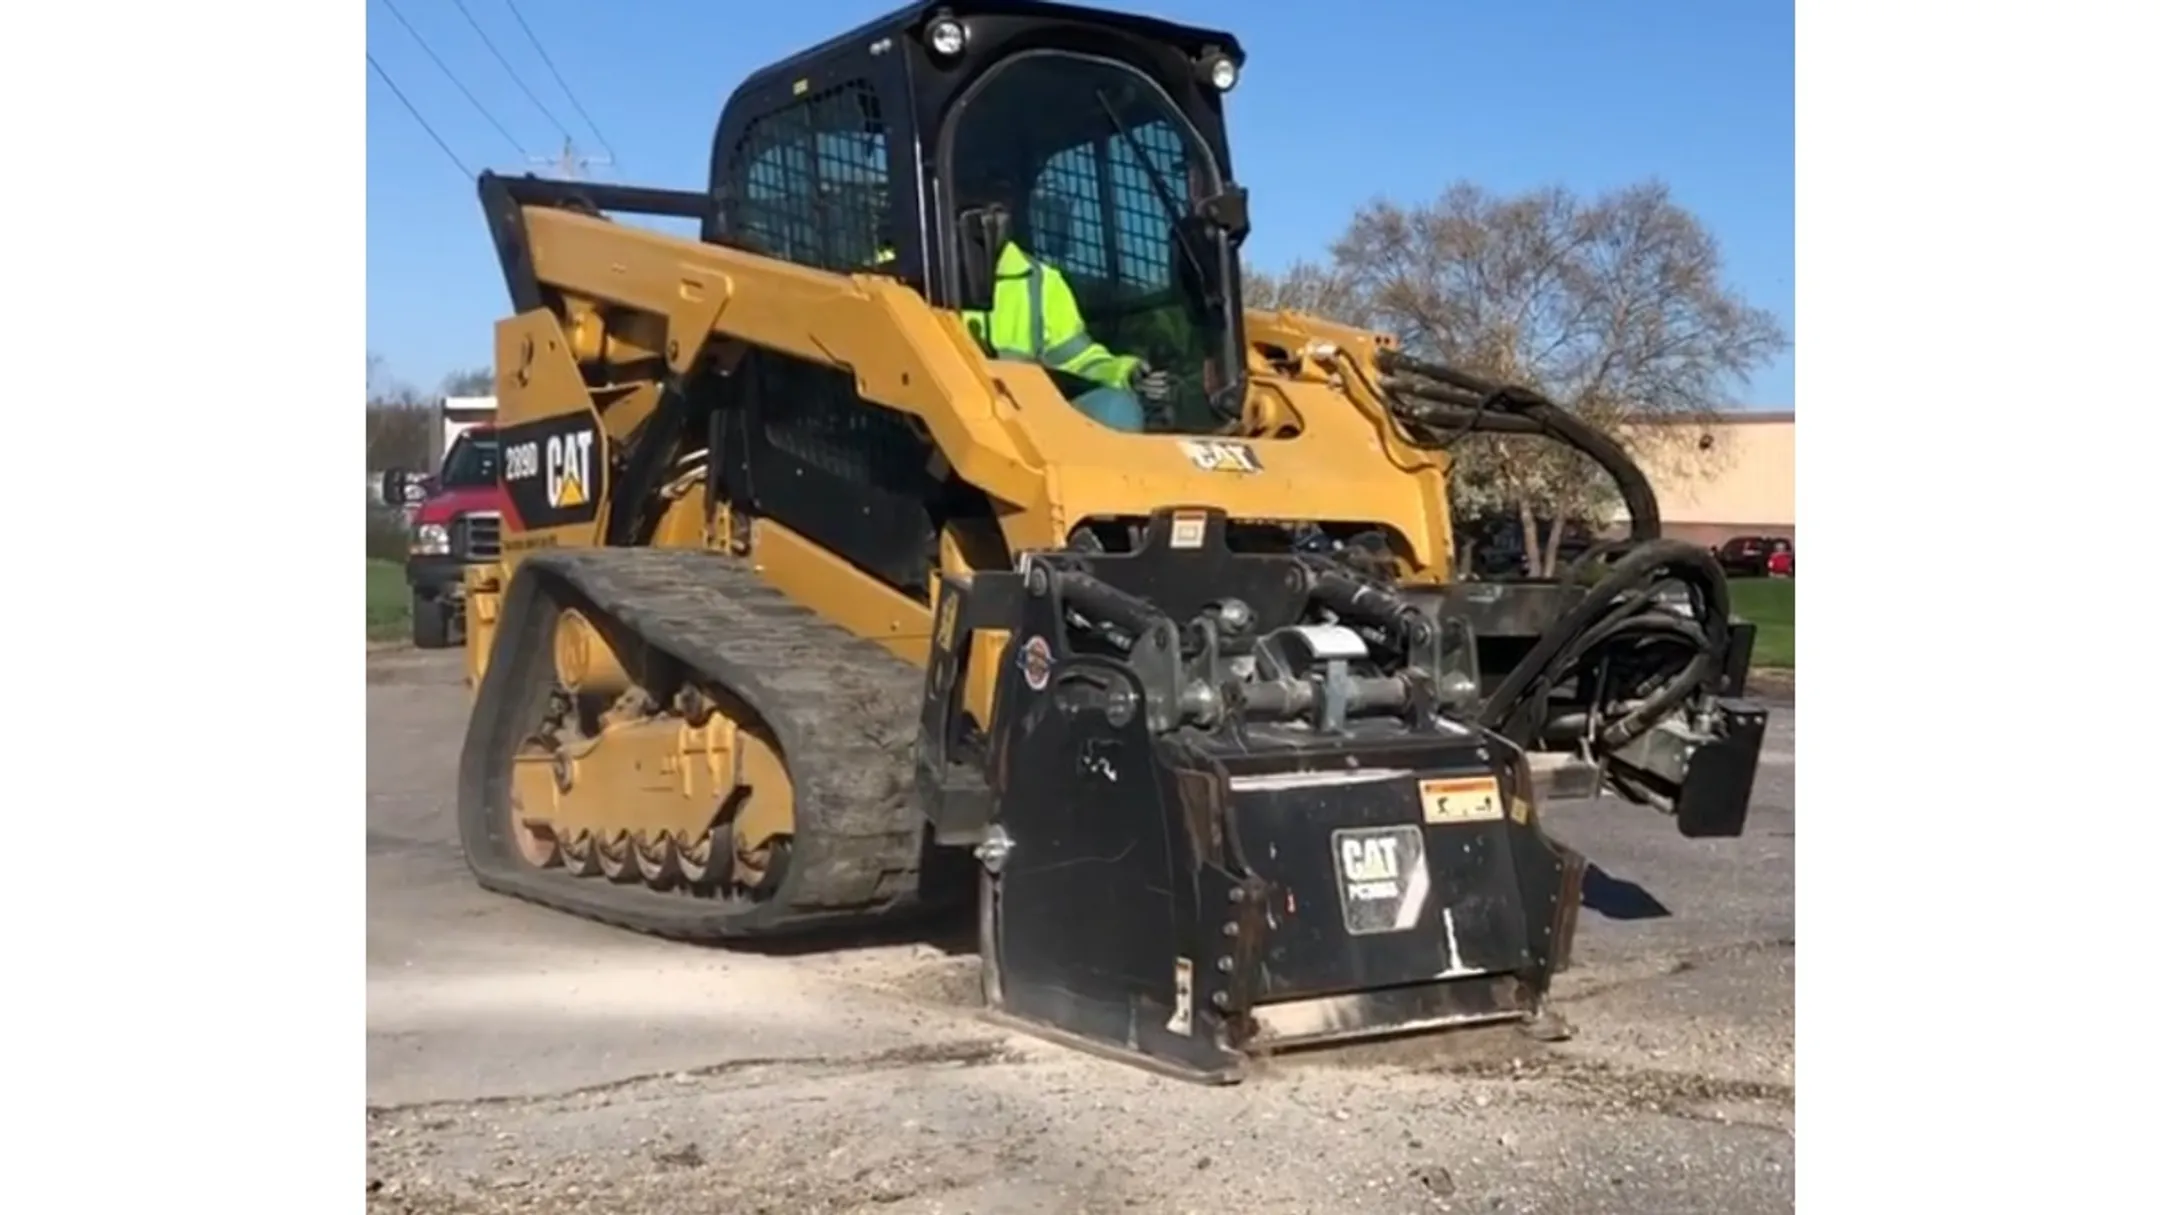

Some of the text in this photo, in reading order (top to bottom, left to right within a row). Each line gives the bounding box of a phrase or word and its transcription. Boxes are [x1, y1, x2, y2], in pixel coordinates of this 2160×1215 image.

[547, 430, 592, 508] CAT
[1190, 441, 1255, 470] CAT
[1342, 837, 1398, 881] CAT
